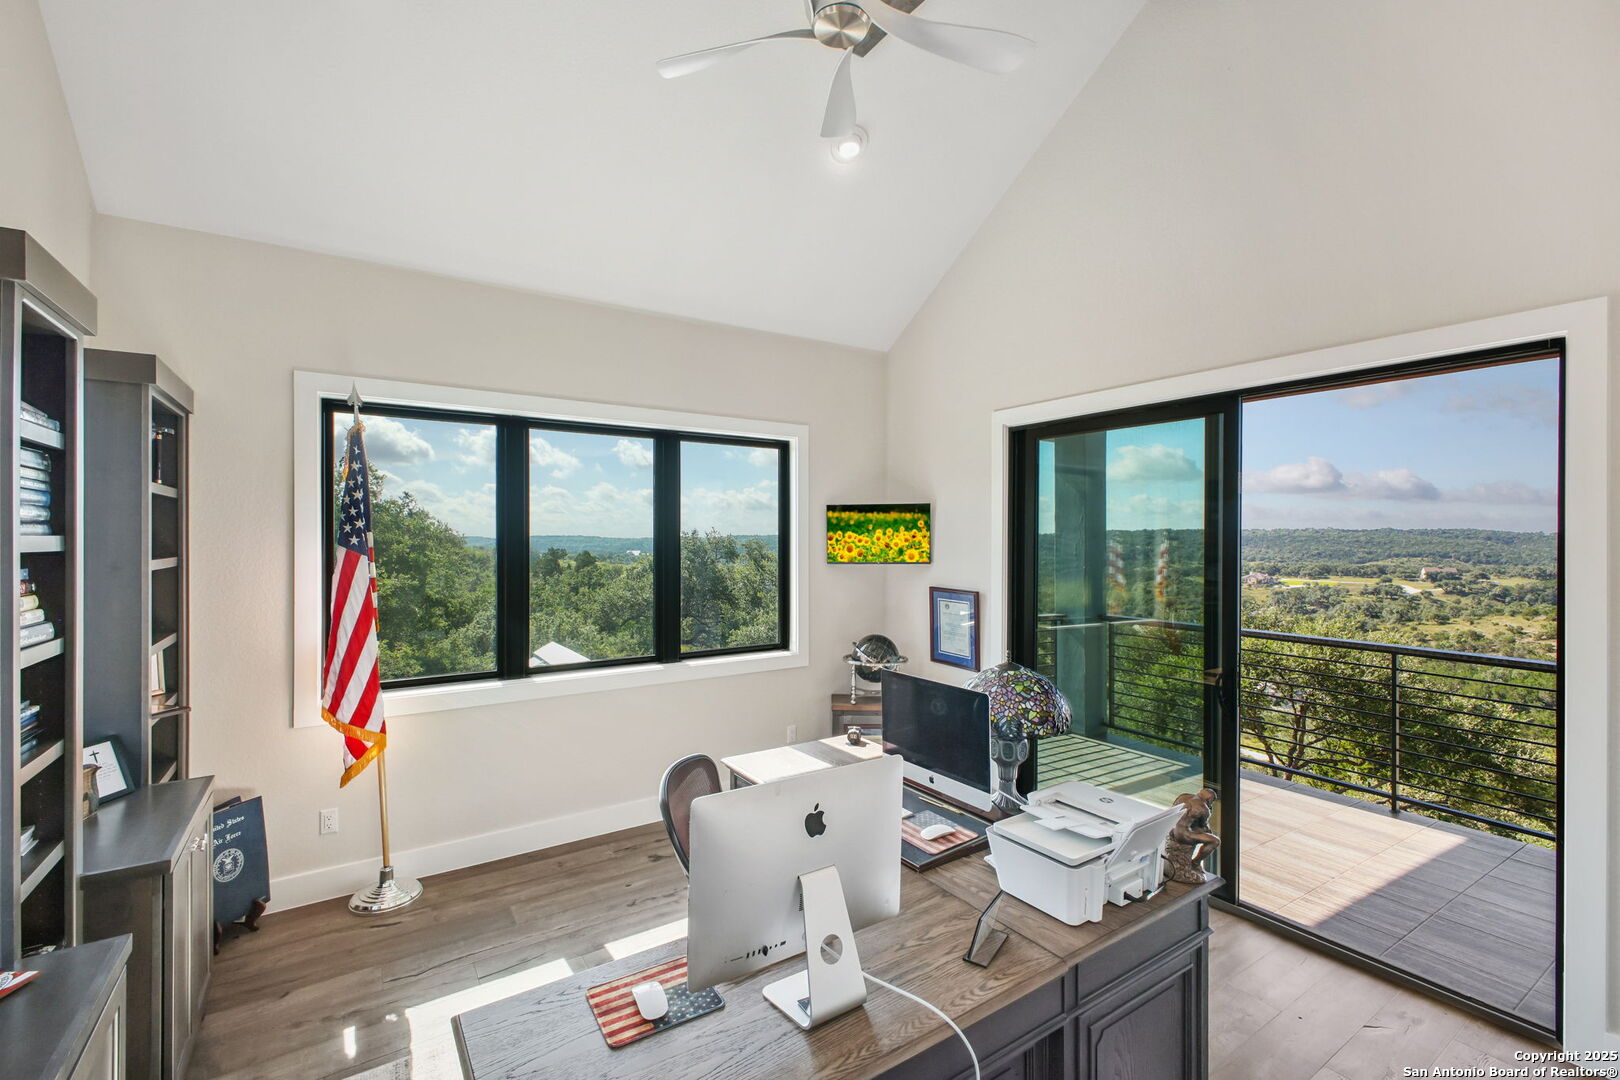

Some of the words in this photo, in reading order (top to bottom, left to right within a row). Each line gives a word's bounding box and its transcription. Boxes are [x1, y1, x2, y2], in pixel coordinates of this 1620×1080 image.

[213, 823, 224, 832] nited
[226, 816, 244, 828] States
[213, 838, 223, 847] Air
[225, 832, 241, 843] Force
